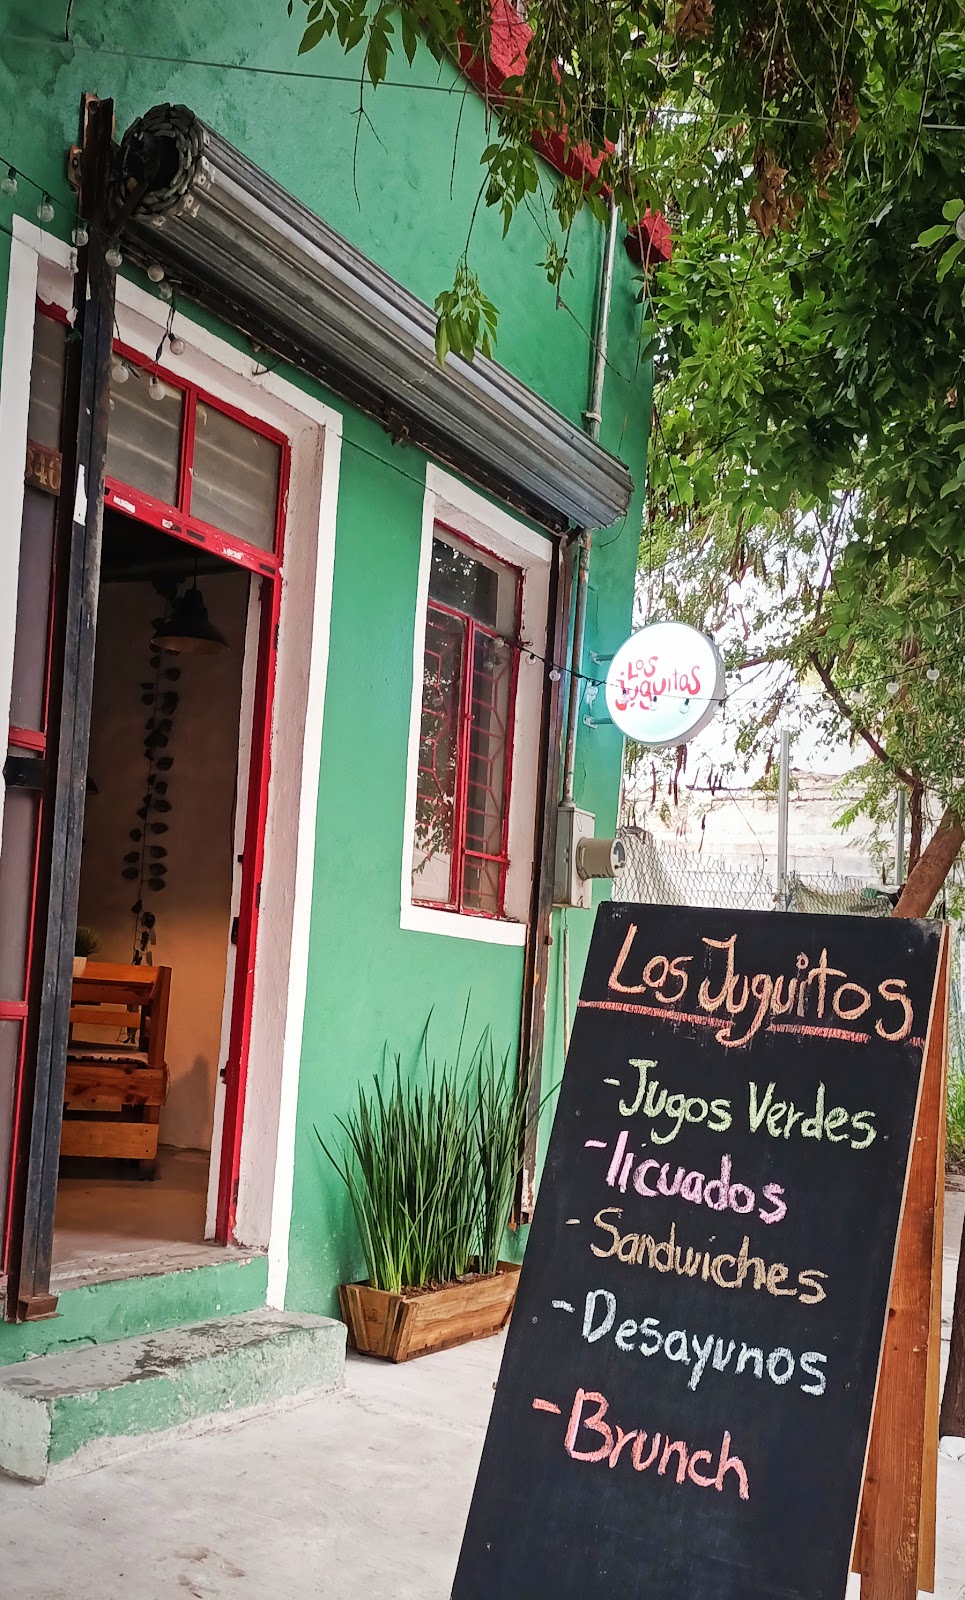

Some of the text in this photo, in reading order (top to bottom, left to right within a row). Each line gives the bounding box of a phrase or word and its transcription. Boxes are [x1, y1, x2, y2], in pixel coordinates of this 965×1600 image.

[607, 923, 913, 1048] Los Juguitos
[748, 1080, 878, 1150] Verdes
